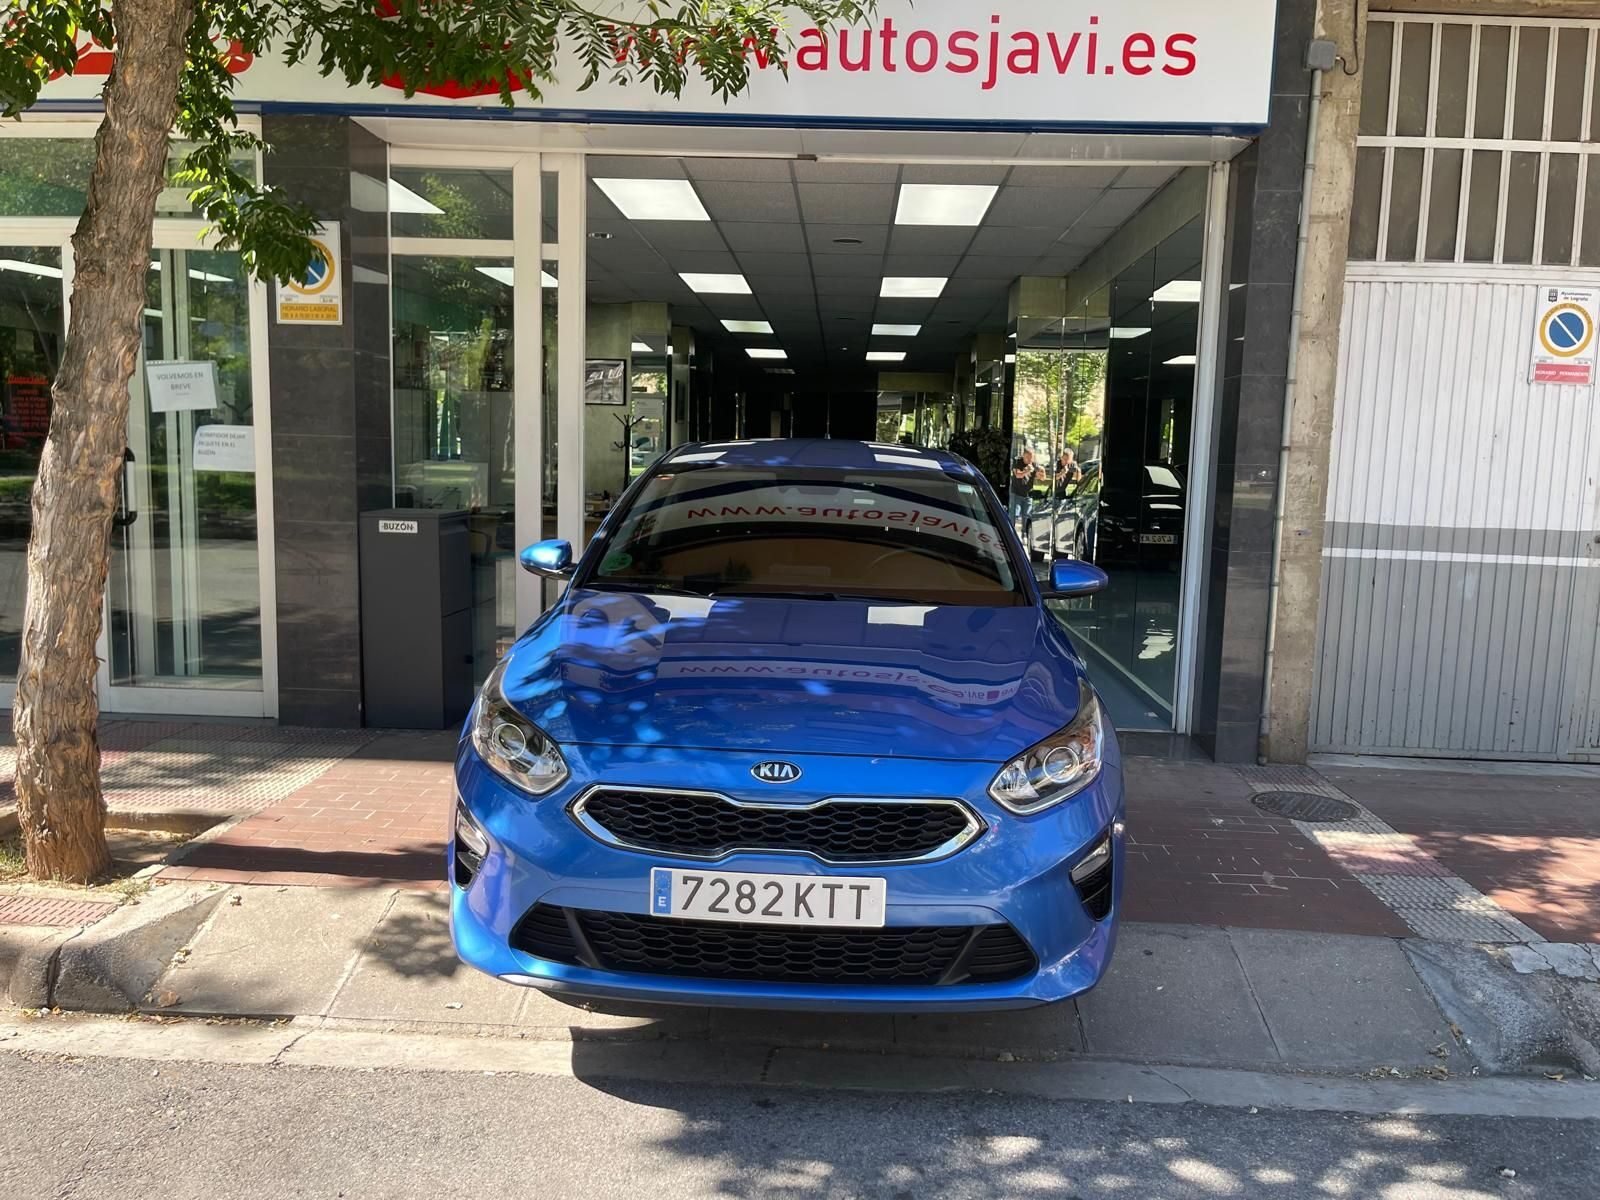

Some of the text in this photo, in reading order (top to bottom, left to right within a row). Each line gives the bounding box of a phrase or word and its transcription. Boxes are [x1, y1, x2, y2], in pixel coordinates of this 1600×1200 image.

[606, 15, 1197, 90] w.autosjavi.es
[170, 383, 192, 391] BREVE
[759, 764, 793, 779] KIA
[658, 876, 871, 920] E 7282 KTT
